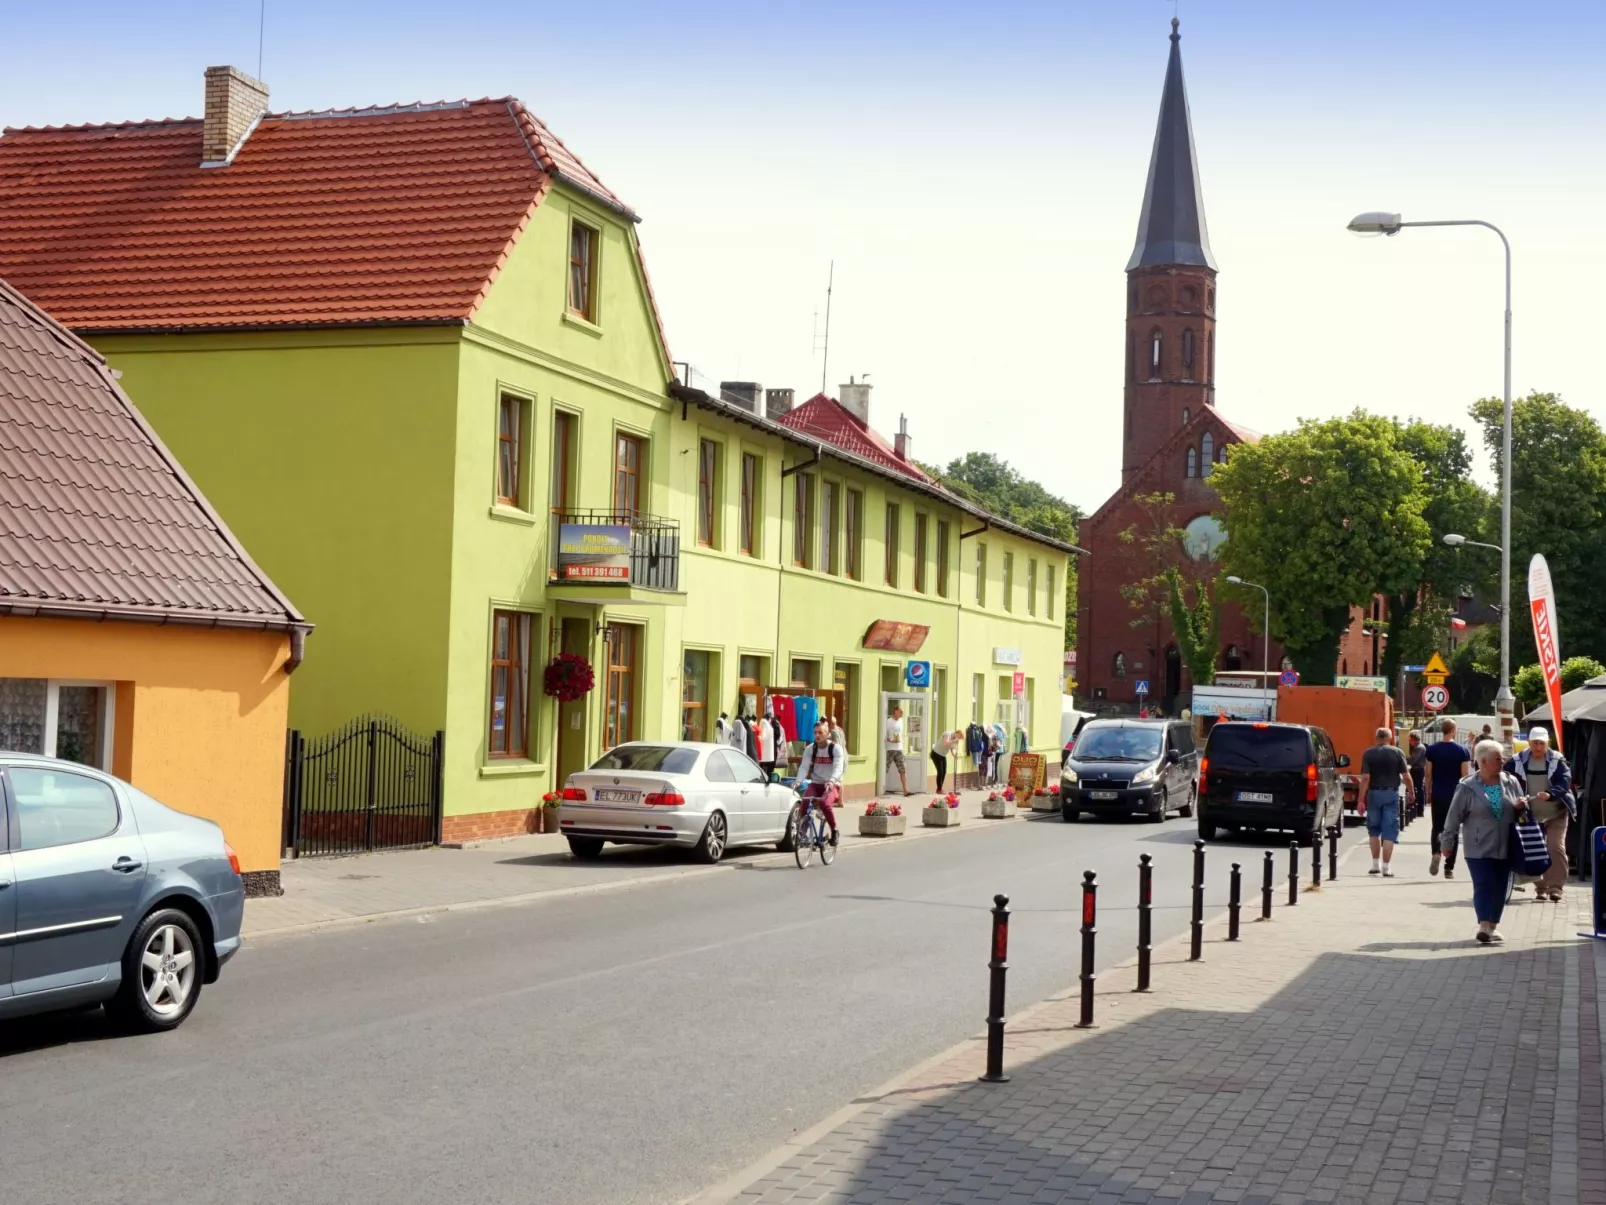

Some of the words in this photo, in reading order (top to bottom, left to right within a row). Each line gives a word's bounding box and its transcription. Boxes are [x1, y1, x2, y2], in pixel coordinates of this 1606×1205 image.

[568, 567, 580, 576] tel.
[581, 567, 593, 576] 511
[595, 568, 607, 577] 391
[608, 568, 623, 577] 468
[910, 679, 925, 687] pepsi
[1427, 690, 1445, 704] 20
[599, 791, 610, 801] EL
[612, 792, 637, 802] 773UK
